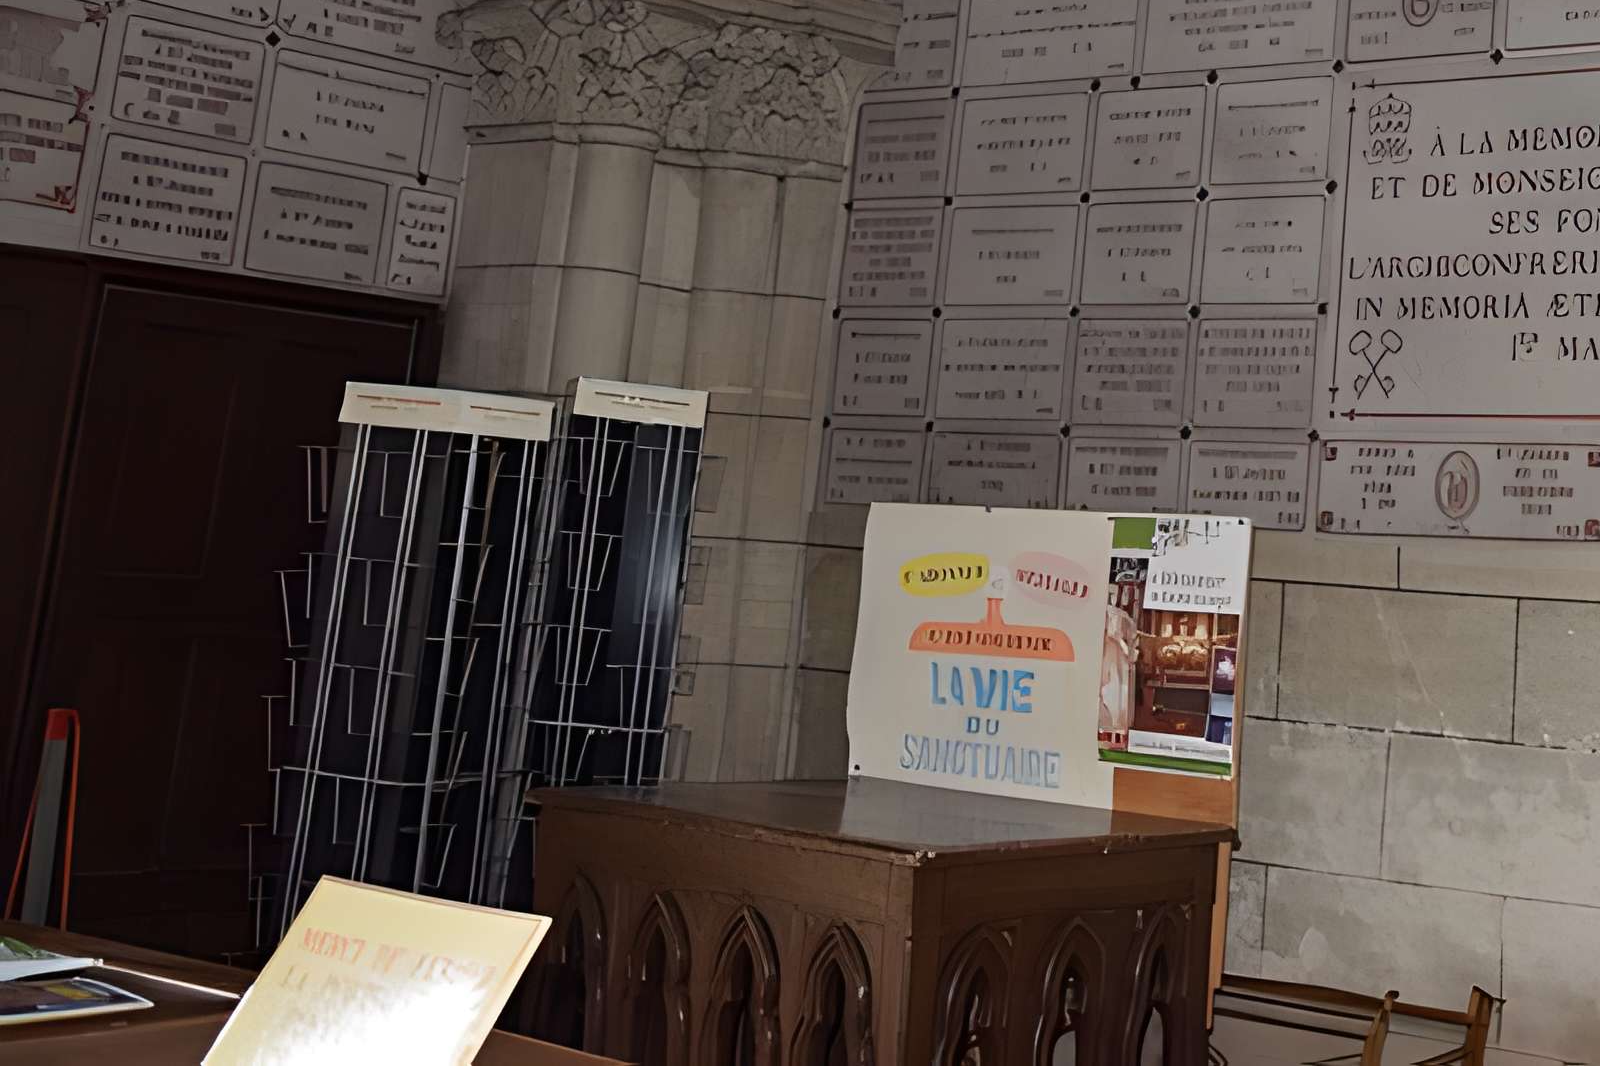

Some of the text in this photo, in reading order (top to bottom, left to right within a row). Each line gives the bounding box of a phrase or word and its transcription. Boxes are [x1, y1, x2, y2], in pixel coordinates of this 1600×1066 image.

[1459, 131, 1494, 156] LA
[1371, 176, 1406, 200] ET
[1422, 173, 1458, 198] DE
[1488, 210, 1540, 234] SES
[1356, 296, 1383, 320] IN
[931, 661, 1035, 713] LA VIE
[966, 716, 999, 736] DU
